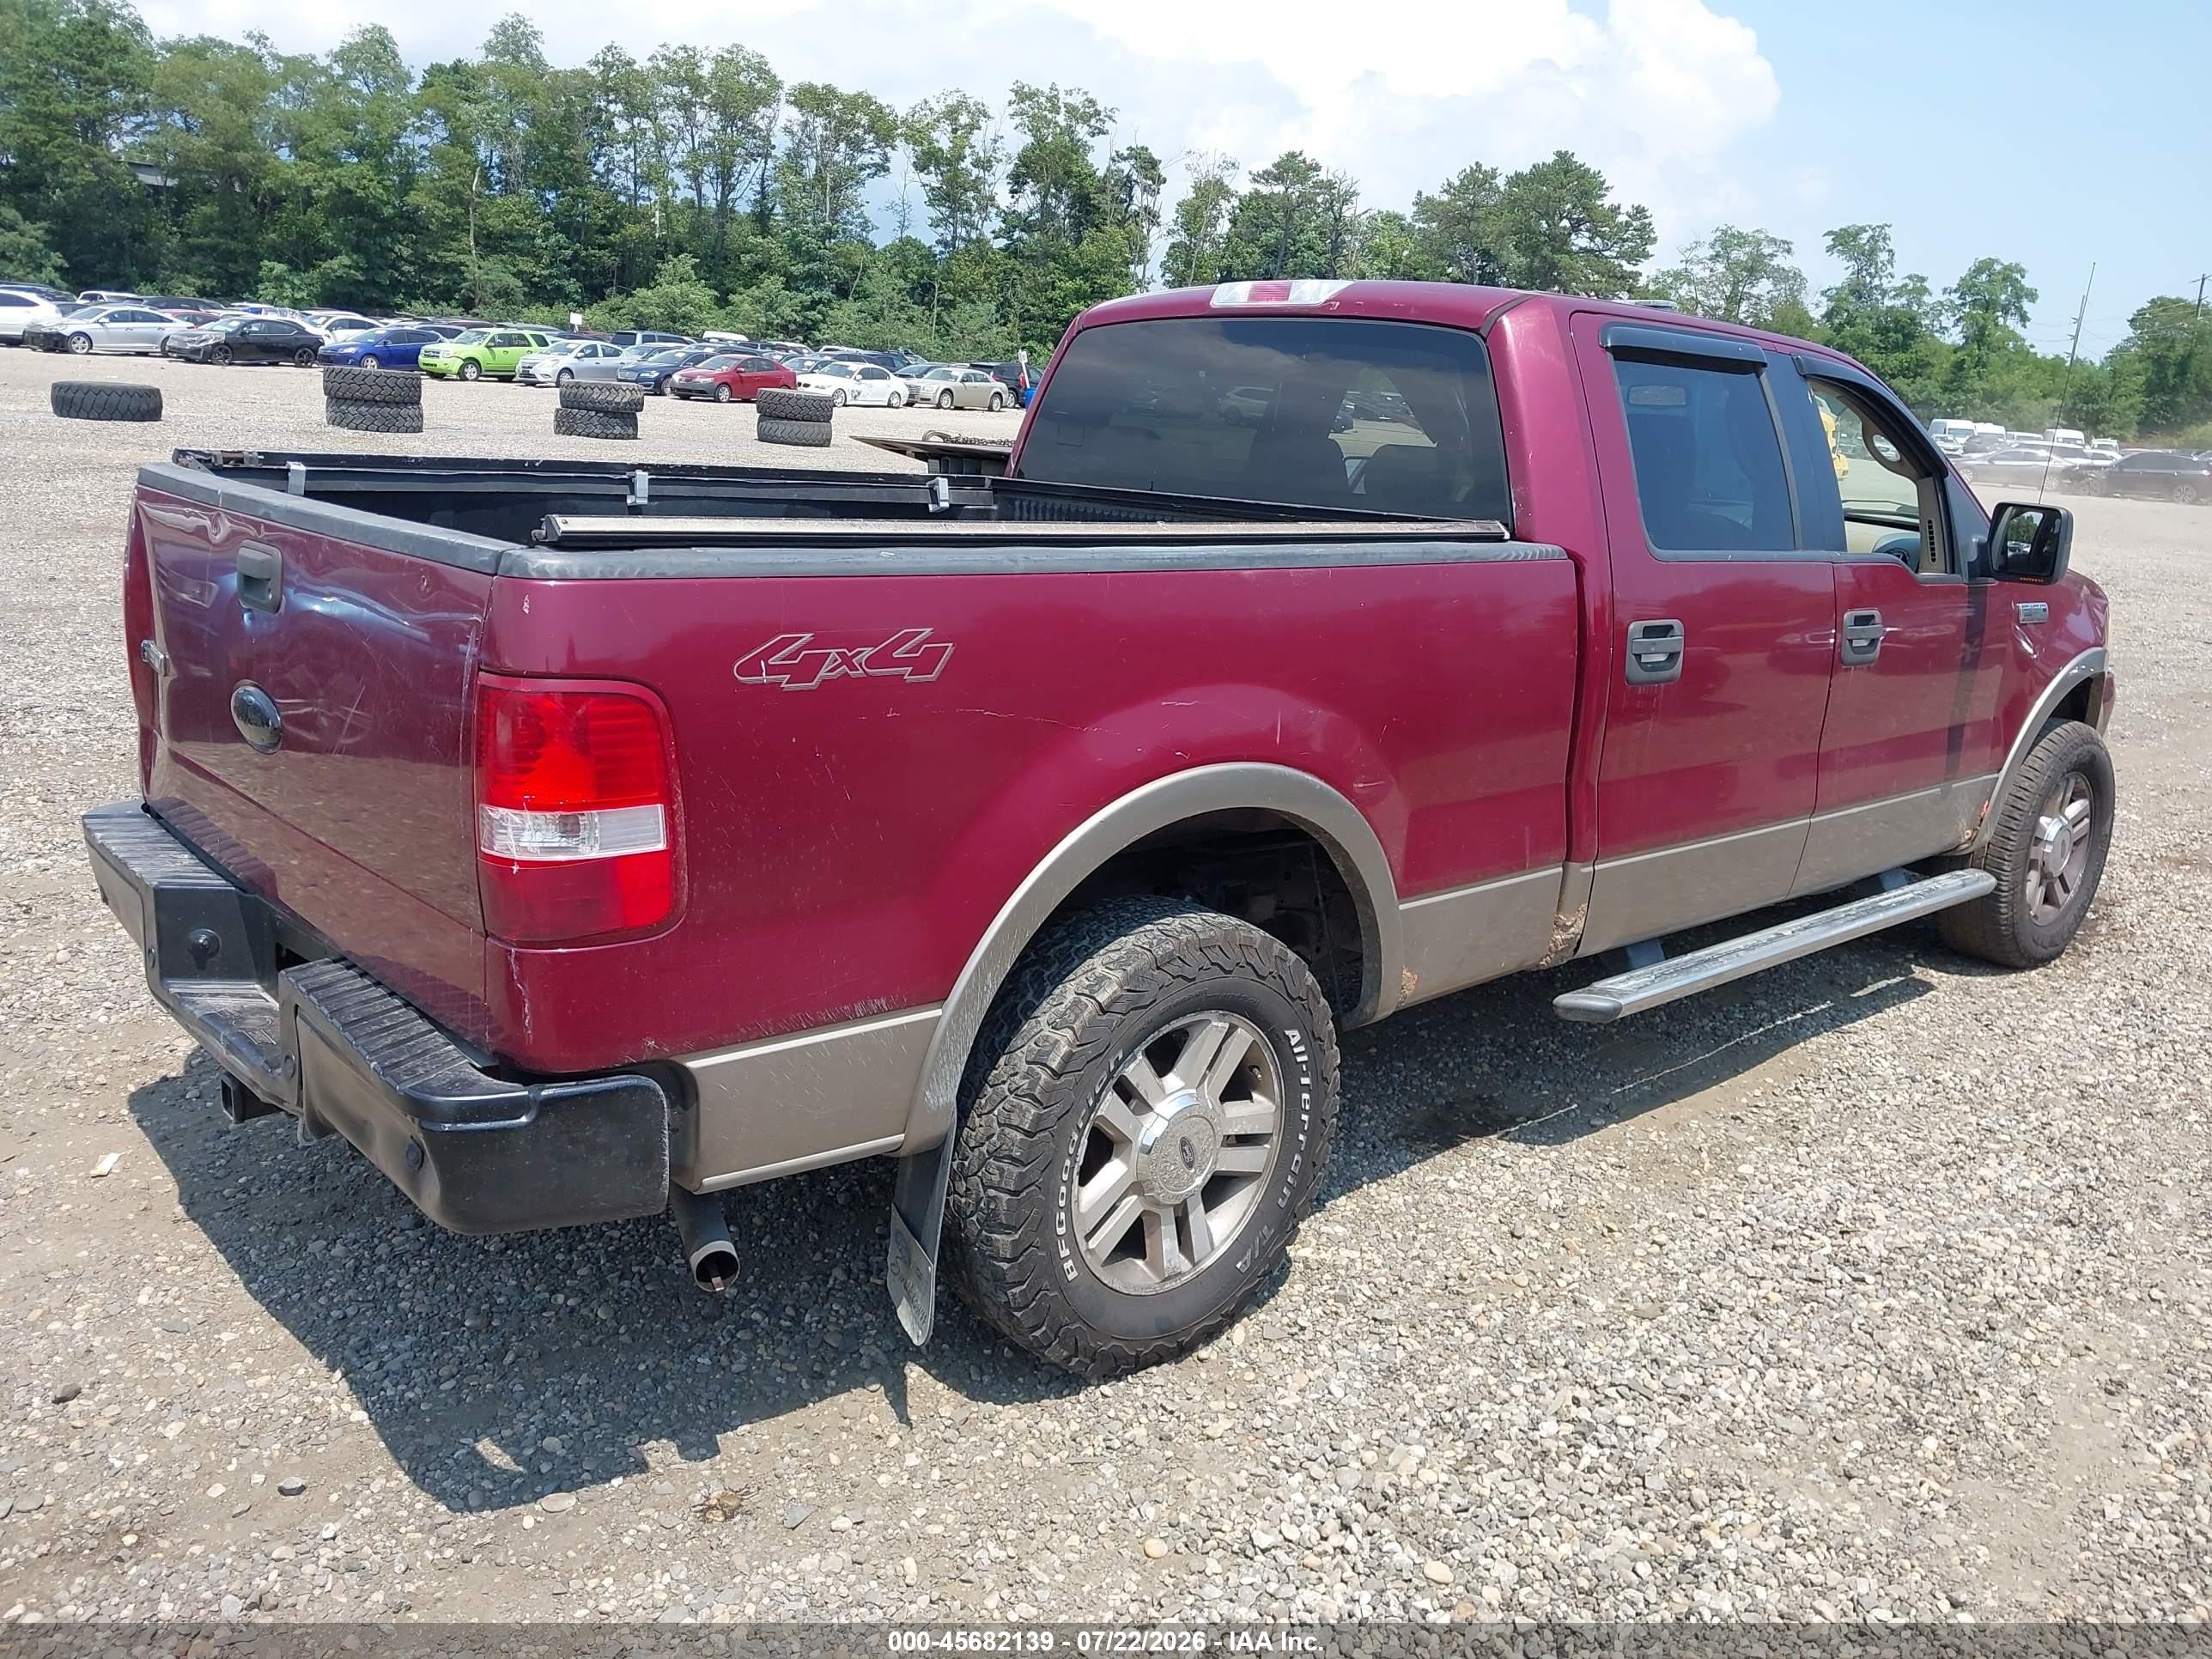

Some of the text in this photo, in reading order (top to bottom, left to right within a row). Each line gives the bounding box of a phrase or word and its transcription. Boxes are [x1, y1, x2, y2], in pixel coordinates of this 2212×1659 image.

[733, 628, 954, 691] 4x4
[1055, 1048, 1123, 1282] BFGoodrich
[1279, 1030, 1313, 1209] All-Terrain
